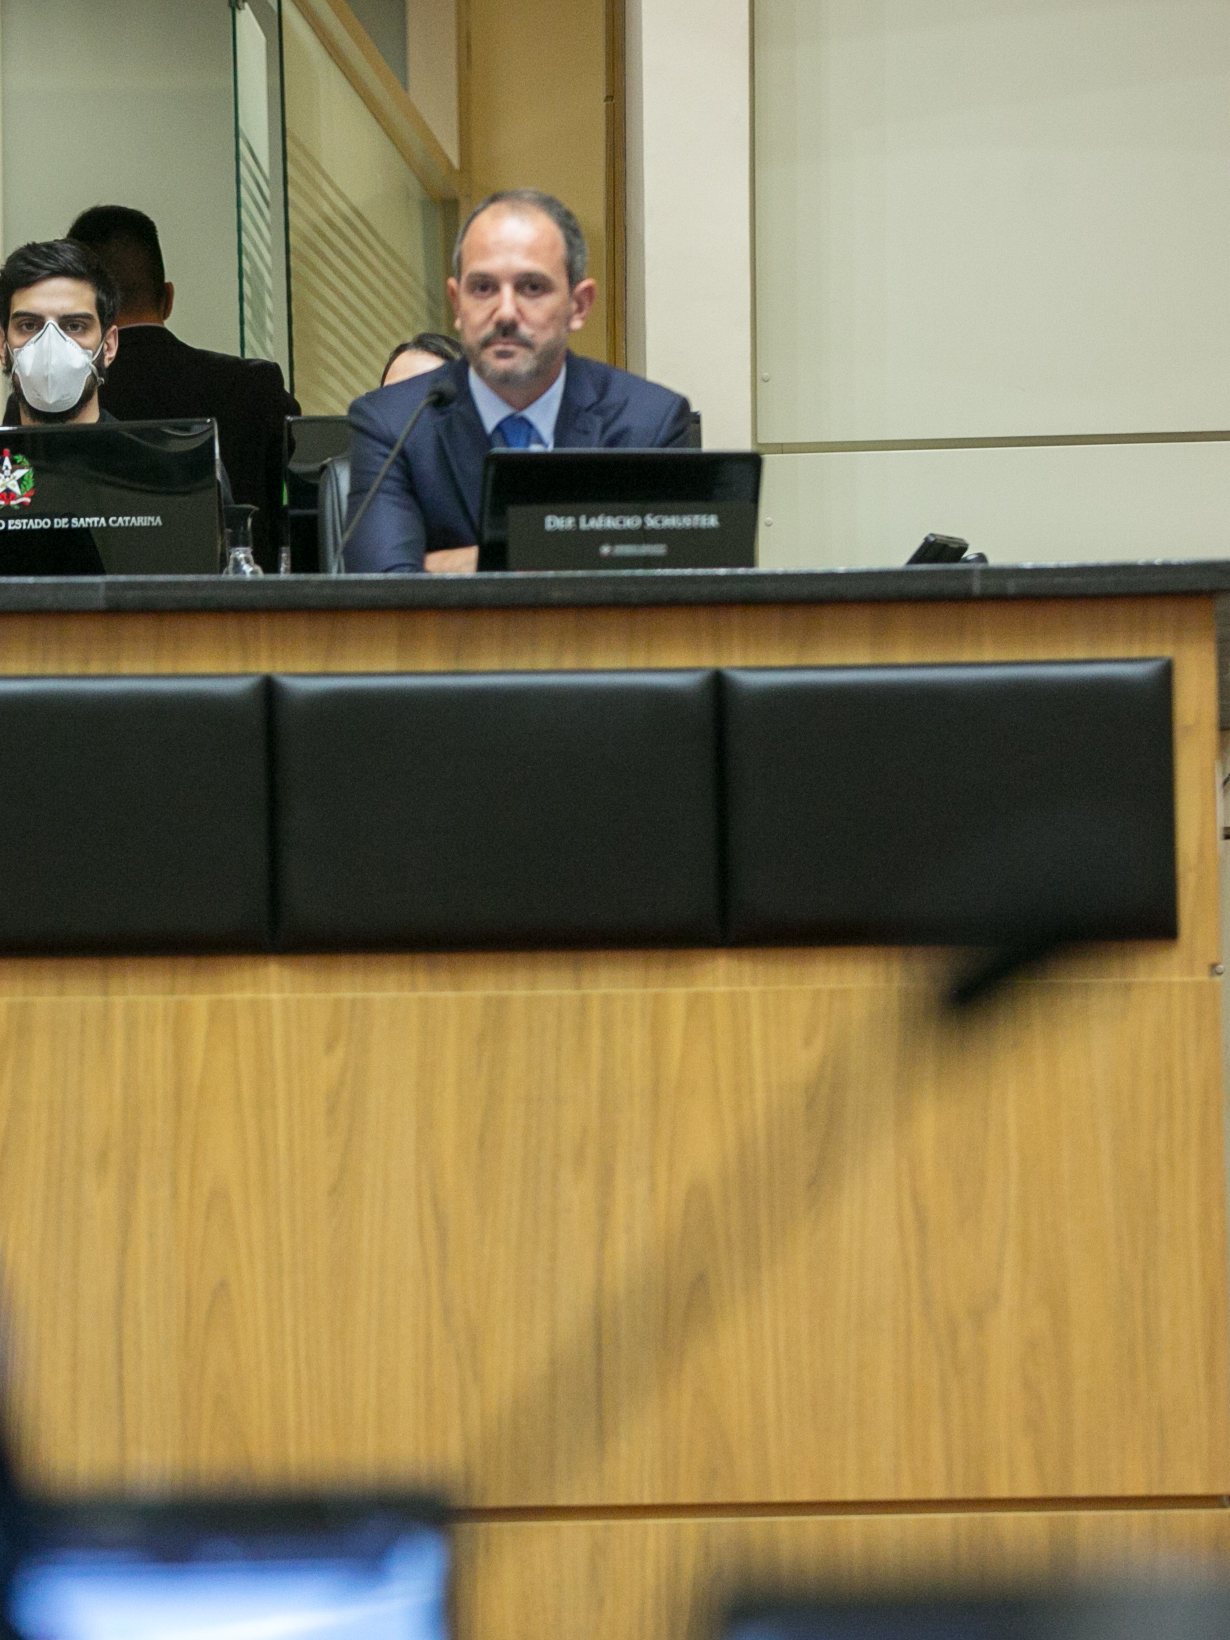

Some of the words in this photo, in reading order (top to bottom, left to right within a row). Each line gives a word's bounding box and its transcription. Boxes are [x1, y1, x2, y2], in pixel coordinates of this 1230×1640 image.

[8, 518, 51, 530] ESTADO
[53, 517, 69, 529] DE
[71, 516, 107, 528] SANTA
[108, 515, 163, 527] CATARINA
